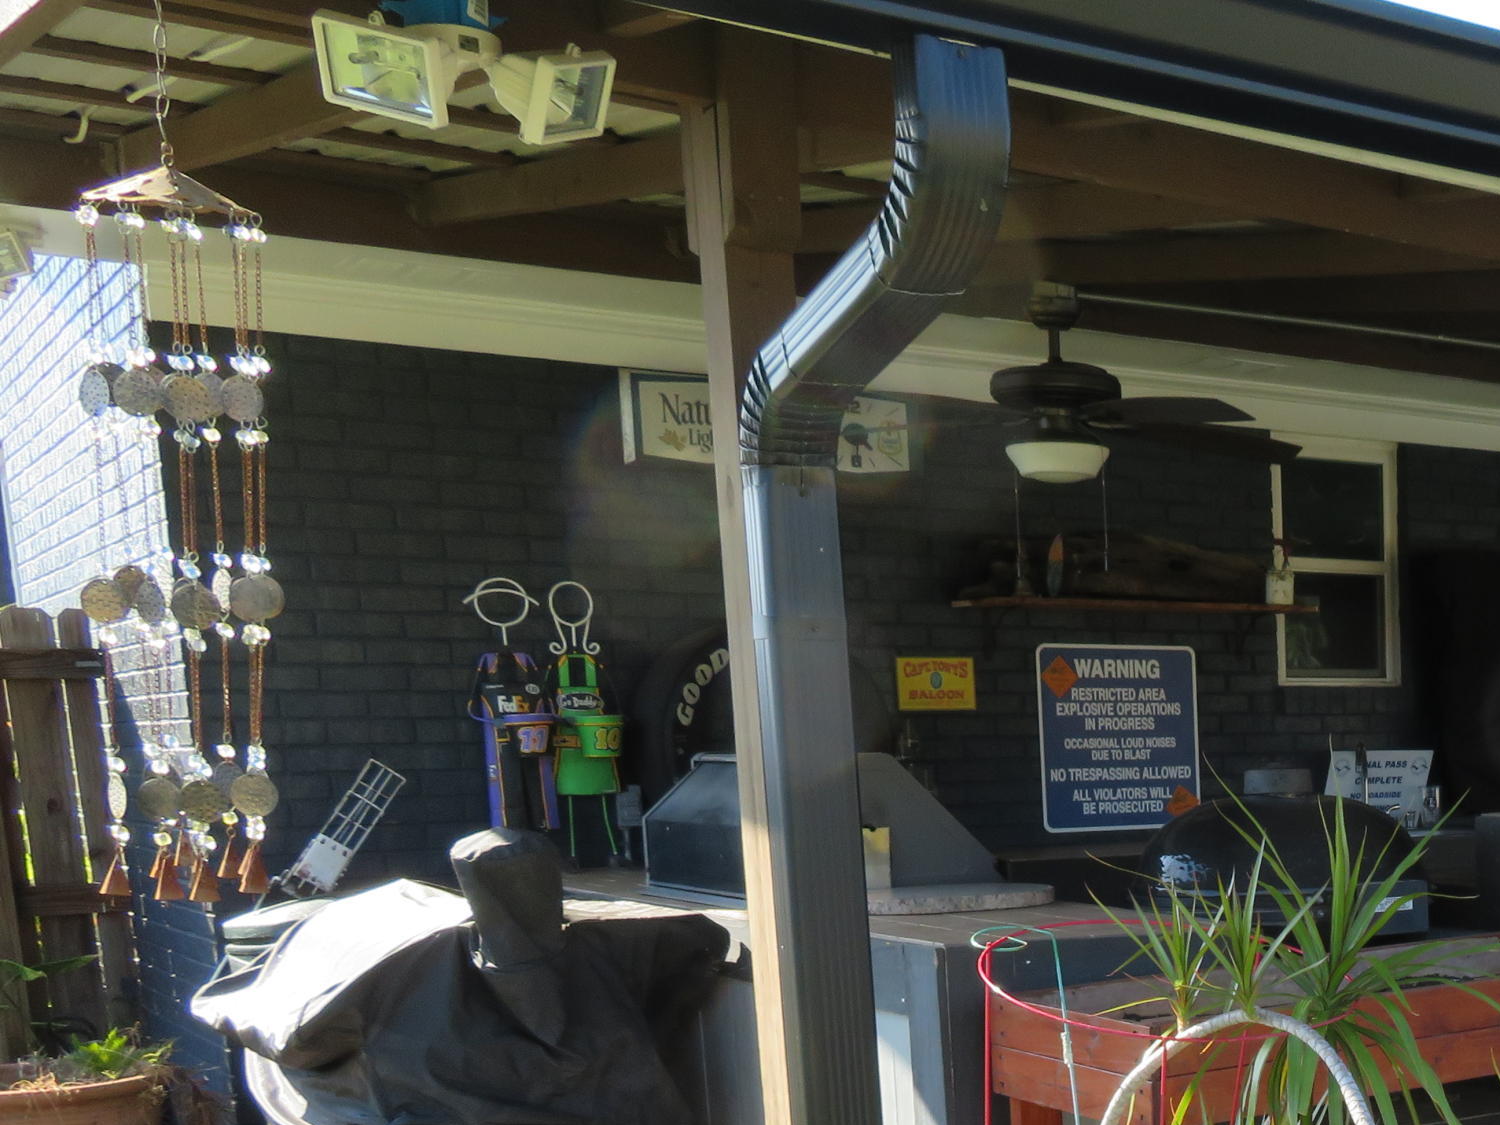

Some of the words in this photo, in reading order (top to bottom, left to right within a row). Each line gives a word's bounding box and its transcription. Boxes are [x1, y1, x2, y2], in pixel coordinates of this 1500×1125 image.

[1074, 659, 1161, 679] WARNING
[908, 689, 965, 700] SALOON
[1071, 688, 1135, 700] RESTRICTED
[1138, 688, 1166, 700] AREA
[497, 695, 530, 713] FedEx
[1056, 703, 1114, 716] EXPLOSIVE
[1117, 702, 1181, 716] OPERATIONS
[1085, 718, 1096, 730] IN
[1099, 717, 1155, 731] PROGRESS
[595, 727, 621, 751] 10
[1064, 738, 1120, 749] OCCASIONAL
[1121, 738, 1144, 749] LOUD
[1146, 737, 1176, 748] NOISES
[1092, 750, 1109, 760] DUE
[1111, 750, 1122, 760] TO
[1124, 749, 1151, 760] BLAST
[1385, 760, 1408, 769] PASS
[1050, 769, 1066, 782] NO
[1069, 767, 1139, 781] TRESPASSING
[1142, 766, 1191, 779] ALLOWED
[1355, 776, 1402, 785] CMPLETE
[1073, 789, 1091, 801] ALL
[1094, 788, 1147, 800] VIOLATORS
[1150, 787, 1173, 799] WILL
[1350, 791, 1362, 799] NO
[1083, 802, 1096, 814] BE
[1099, 801, 1163, 814] PROSECUTED
